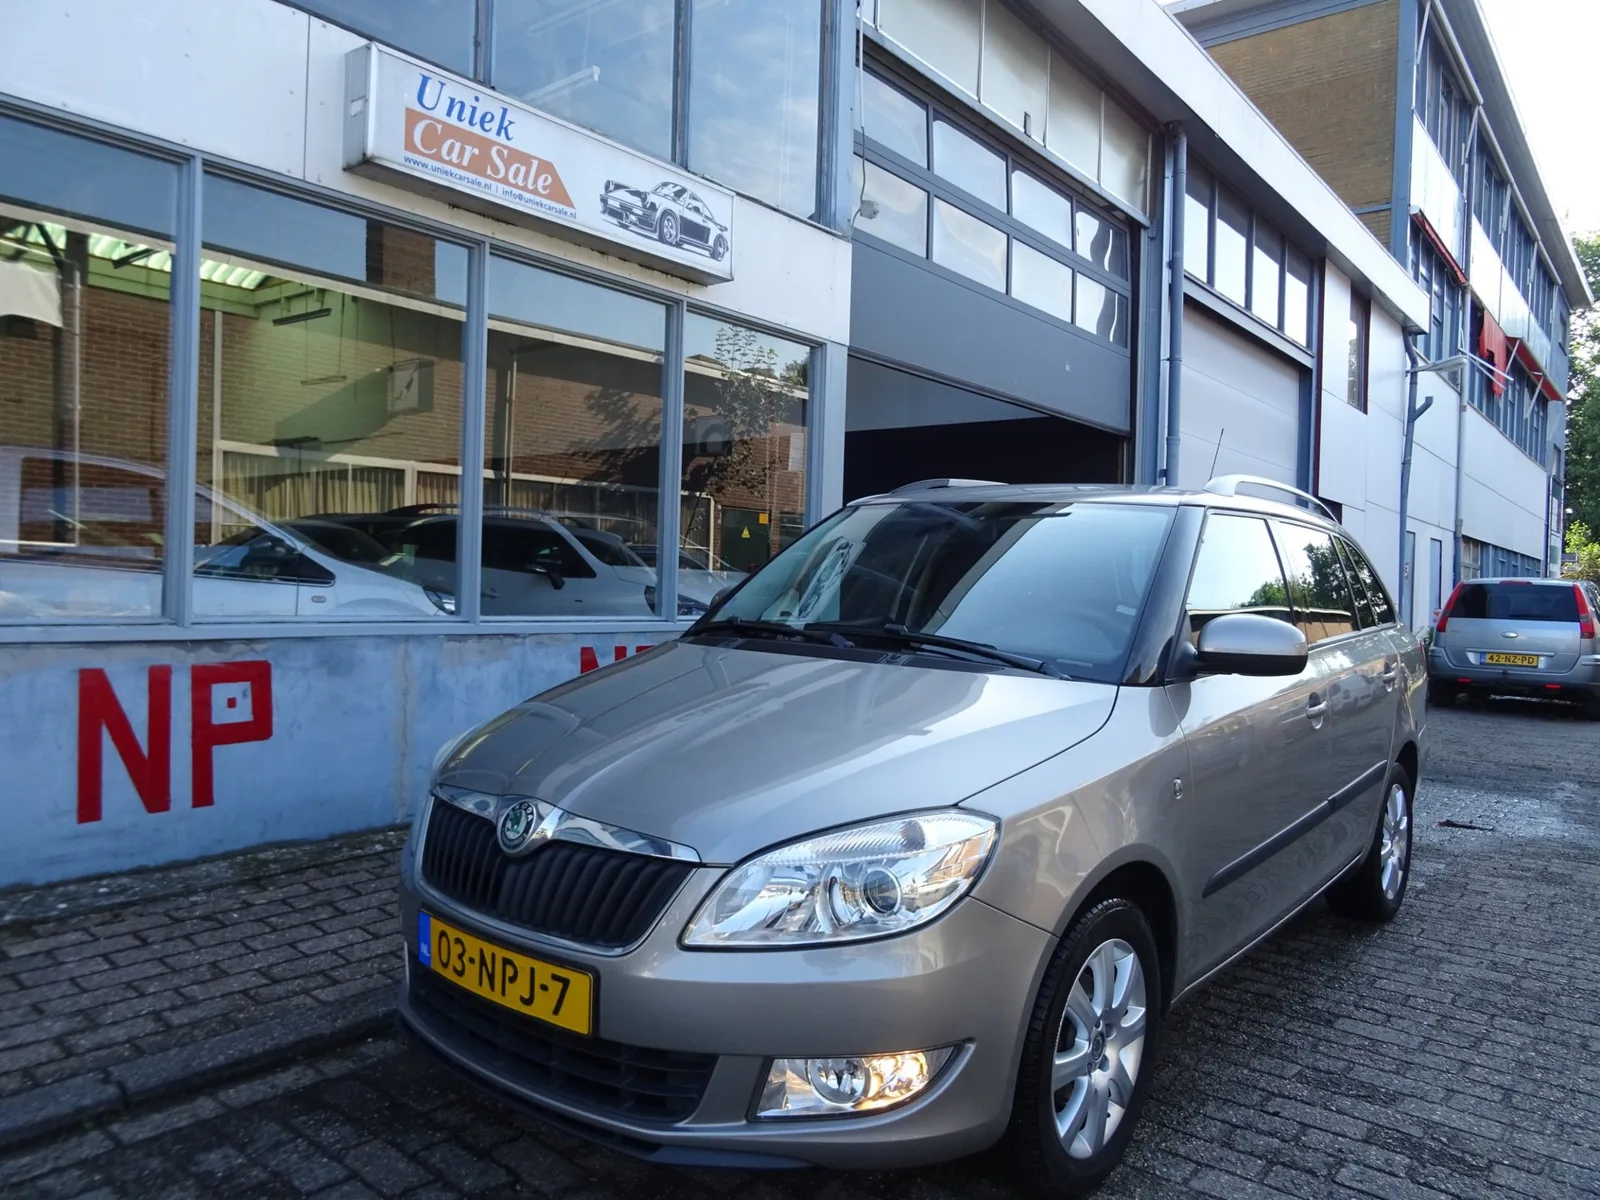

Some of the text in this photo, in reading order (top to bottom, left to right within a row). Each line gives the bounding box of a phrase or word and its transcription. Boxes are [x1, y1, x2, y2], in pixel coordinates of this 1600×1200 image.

[417, 73, 515, 141] Uniek
[403, 155, 492, 191] www.uniekcarsale.nl
[502, 187, 577, 219] info@uniekcarsale.nl
[413, 119, 552, 194] Car Sale
[1488, 654, 1535, 665] 42-NZ-PD
[77, 660, 273, 823] NP
[438, 930, 571, 1016] 03-NPJ-7
